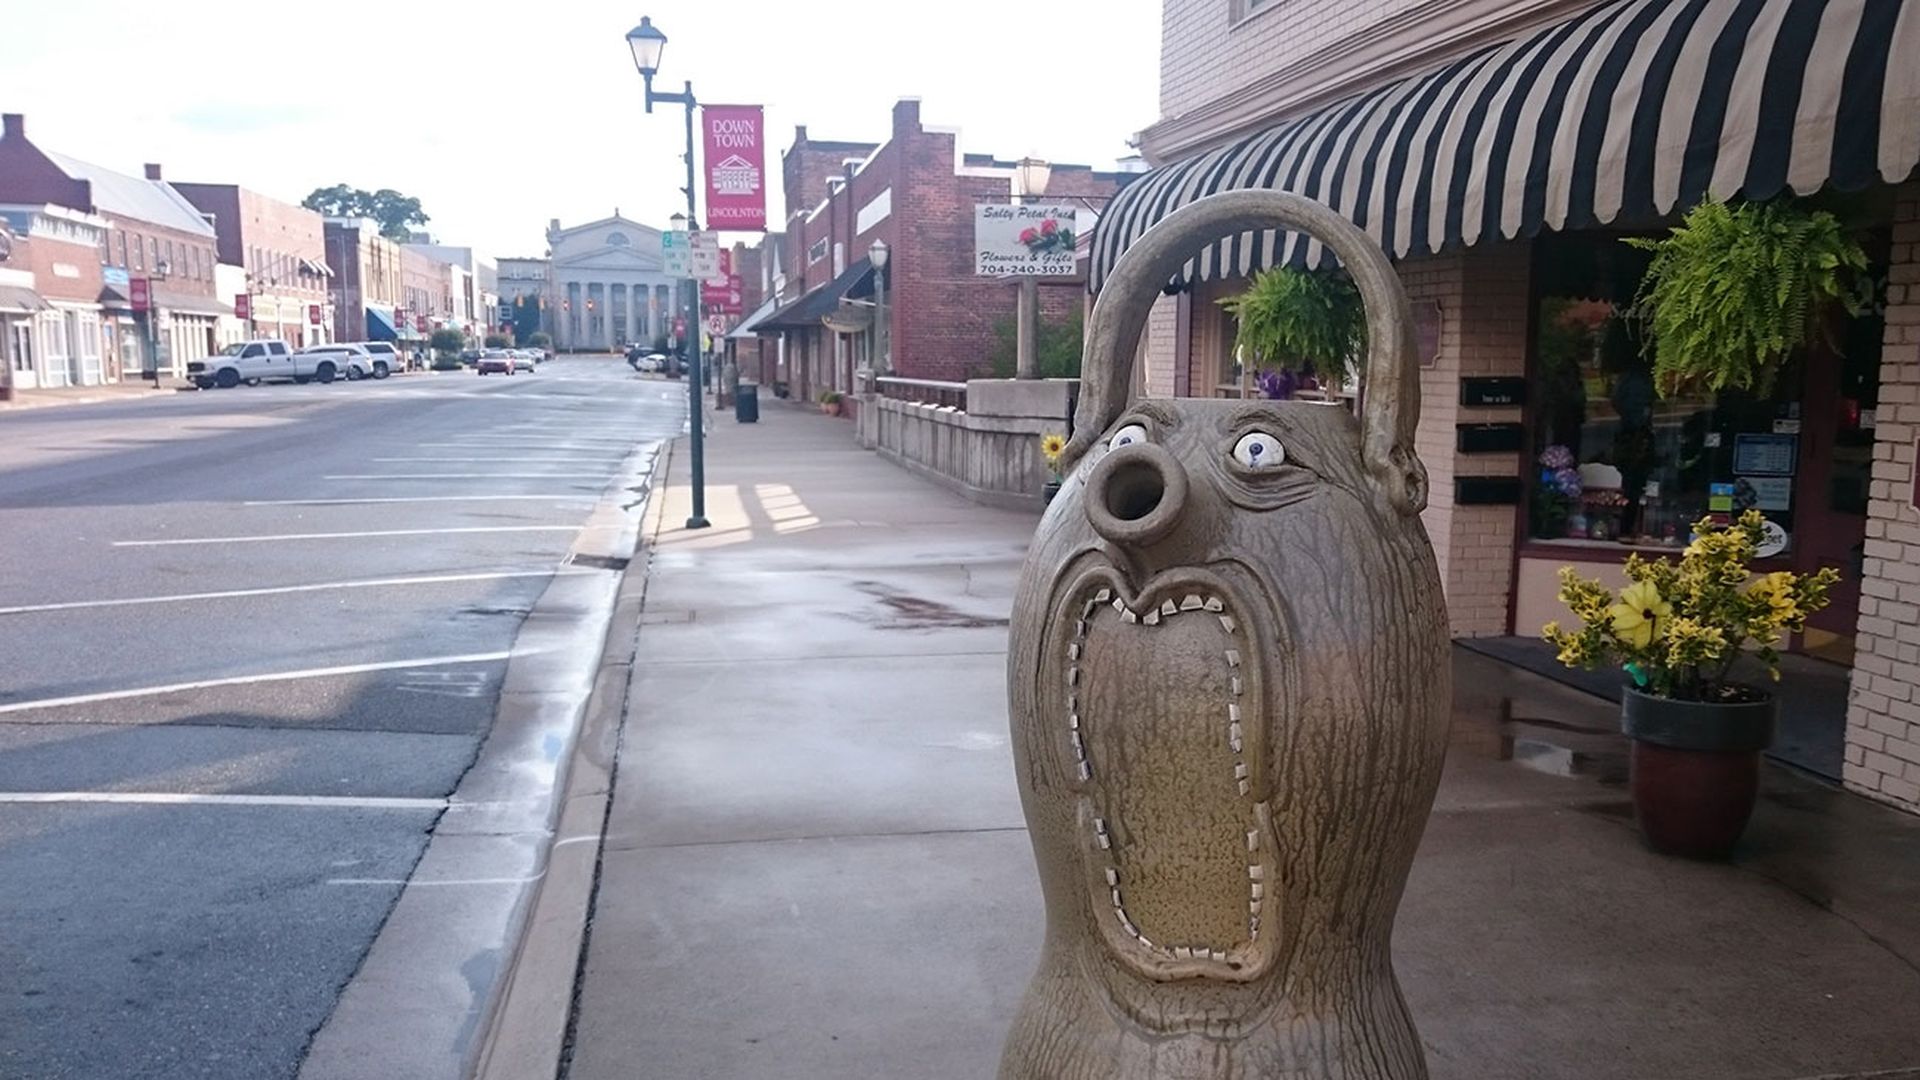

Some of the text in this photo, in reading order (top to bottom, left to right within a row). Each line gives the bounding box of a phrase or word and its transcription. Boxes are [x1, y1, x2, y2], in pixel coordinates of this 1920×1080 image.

[712, 119, 755, 134] DOWN
[713, 134, 755, 148] TOWN
[708, 207, 766, 218] LINCOLNTON
[984, 206, 1014, 220] Salty
[1017, 207, 1048, 218] Petal
[980, 251, 1072, 265] Flowers & Gifts
[980, 265, 1072, 274] 704-240-3037
